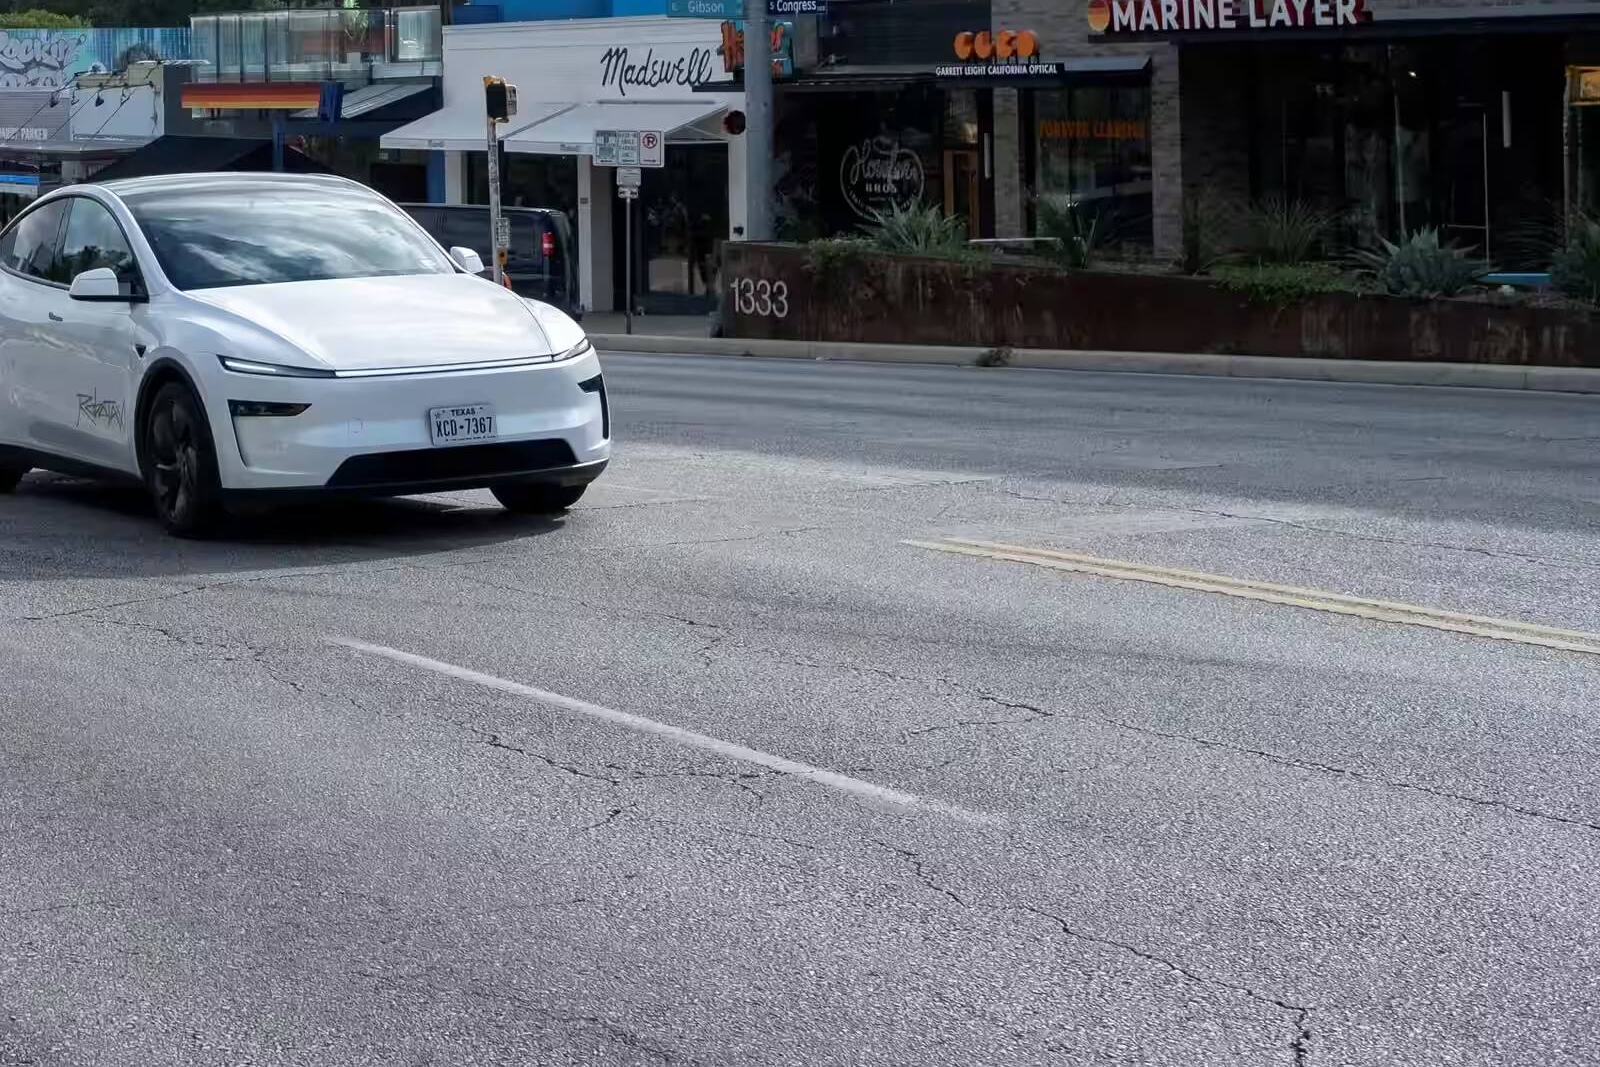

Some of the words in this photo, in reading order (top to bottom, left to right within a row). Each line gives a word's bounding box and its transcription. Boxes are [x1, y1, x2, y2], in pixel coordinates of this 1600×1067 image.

[687, 0, 725, 14] Gibson
[600, 47, 712, 96] Madewell
[987, 65, 1027, 75] CALIFORNIA
[1029, 65, 1057, 74] OPTICAL
[729, 277, 789, 318] 1333
[451, 407, 476, 416] TEXAS
